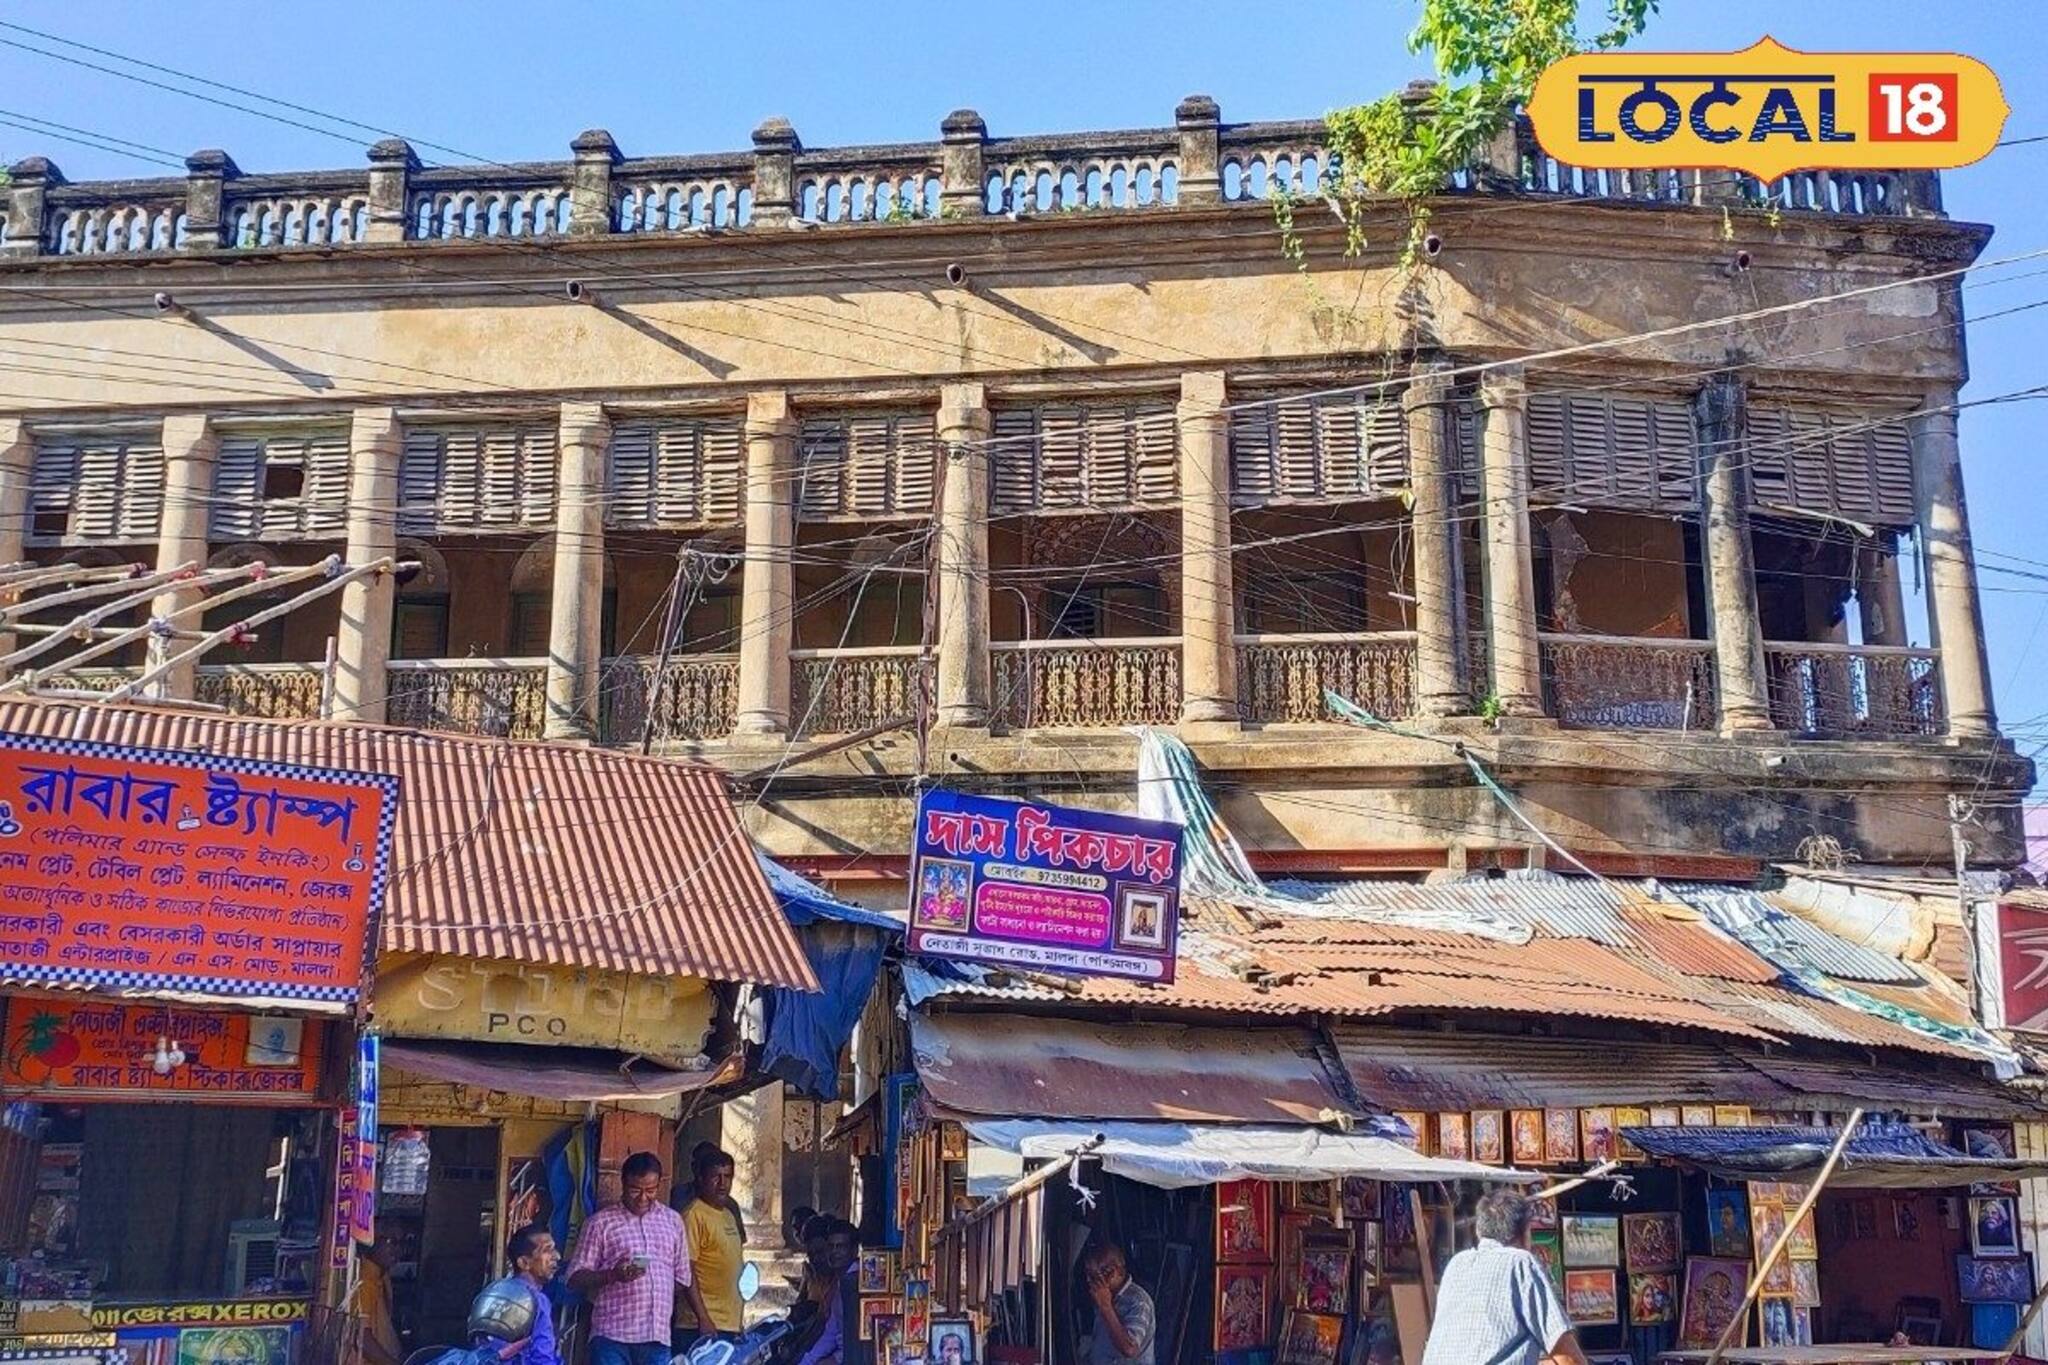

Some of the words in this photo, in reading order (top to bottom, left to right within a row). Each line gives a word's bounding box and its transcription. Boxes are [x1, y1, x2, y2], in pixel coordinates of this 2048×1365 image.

[18, 765, 180, 825] রাবার
[926, 809, 1009, 858] দাস
[1016, 806, 1177, 884] পিকচার
[88, 856, 143, 881] টেবিল
[301, 880, 354, 902] জেরক্স
[90, 893, 103, 908] ও
[108, 888, 149, 910] সঠিক
[73, 922, 109, 940] এবং
[120, 923, 205, 946] বেসরকারী
[213, 928, 264, 951] অর্ডার
[58, 942, 152, 966] এন্টারপ্রাইজ
[488, 1012, 567, 1037] PCO
[72, 1065, 122, 1087] রাবার
[214, 1302, 307, 1321] XEROX
